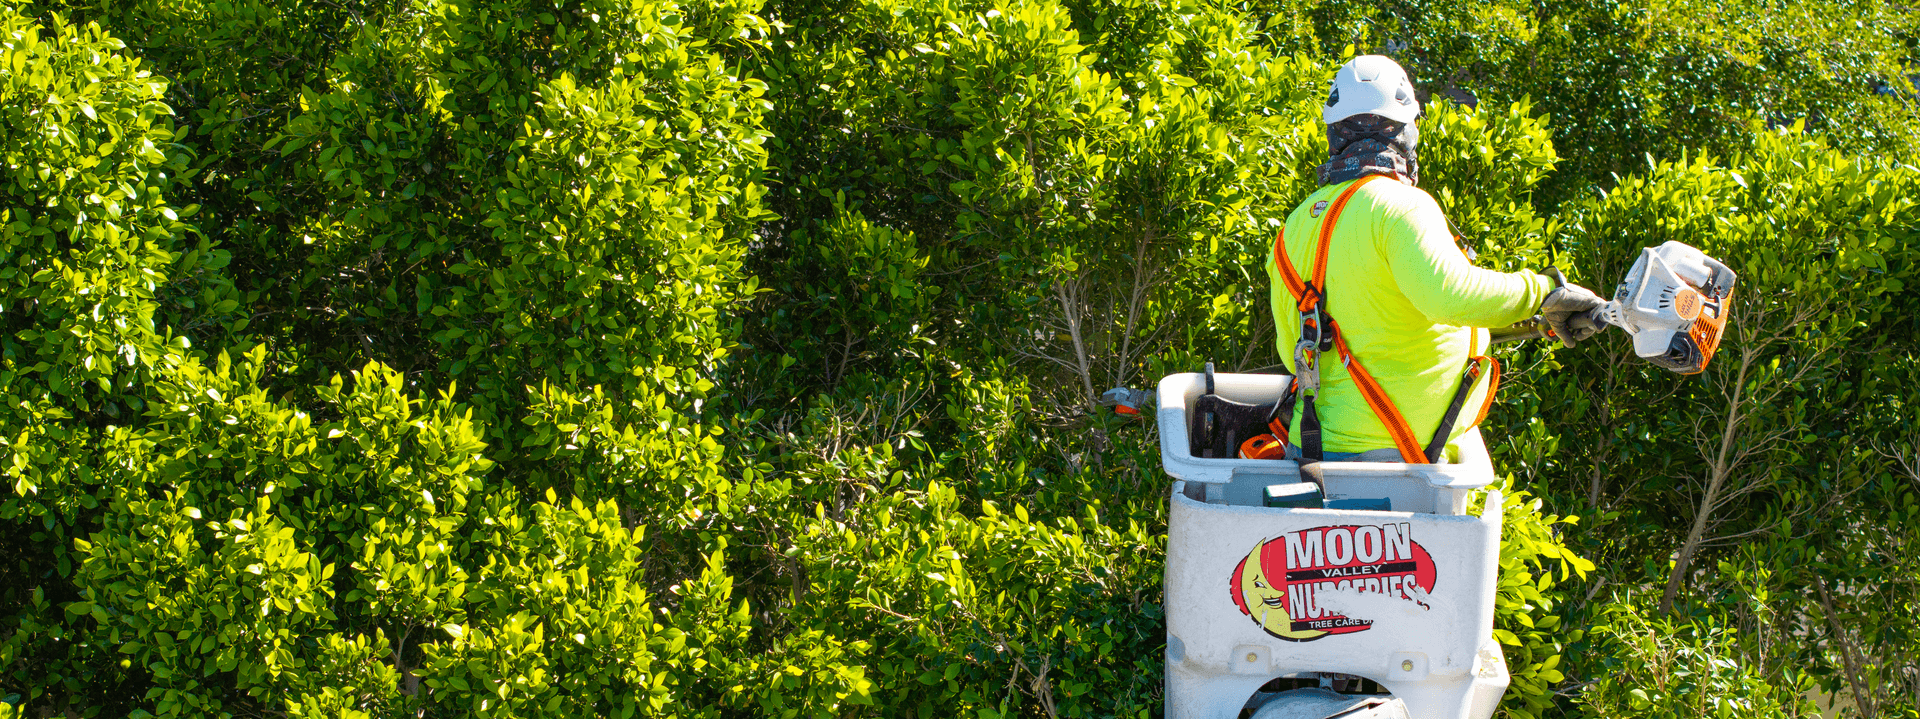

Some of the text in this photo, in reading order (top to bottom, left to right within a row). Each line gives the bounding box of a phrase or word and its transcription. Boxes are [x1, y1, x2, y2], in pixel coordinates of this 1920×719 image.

[1285, 522, 1412, 570] MOON
[1322, 565, 1382, 577] VALLEY
[1309, 619, 1333, 629] TREE
[1335, 618, 1361, 627] CARE
